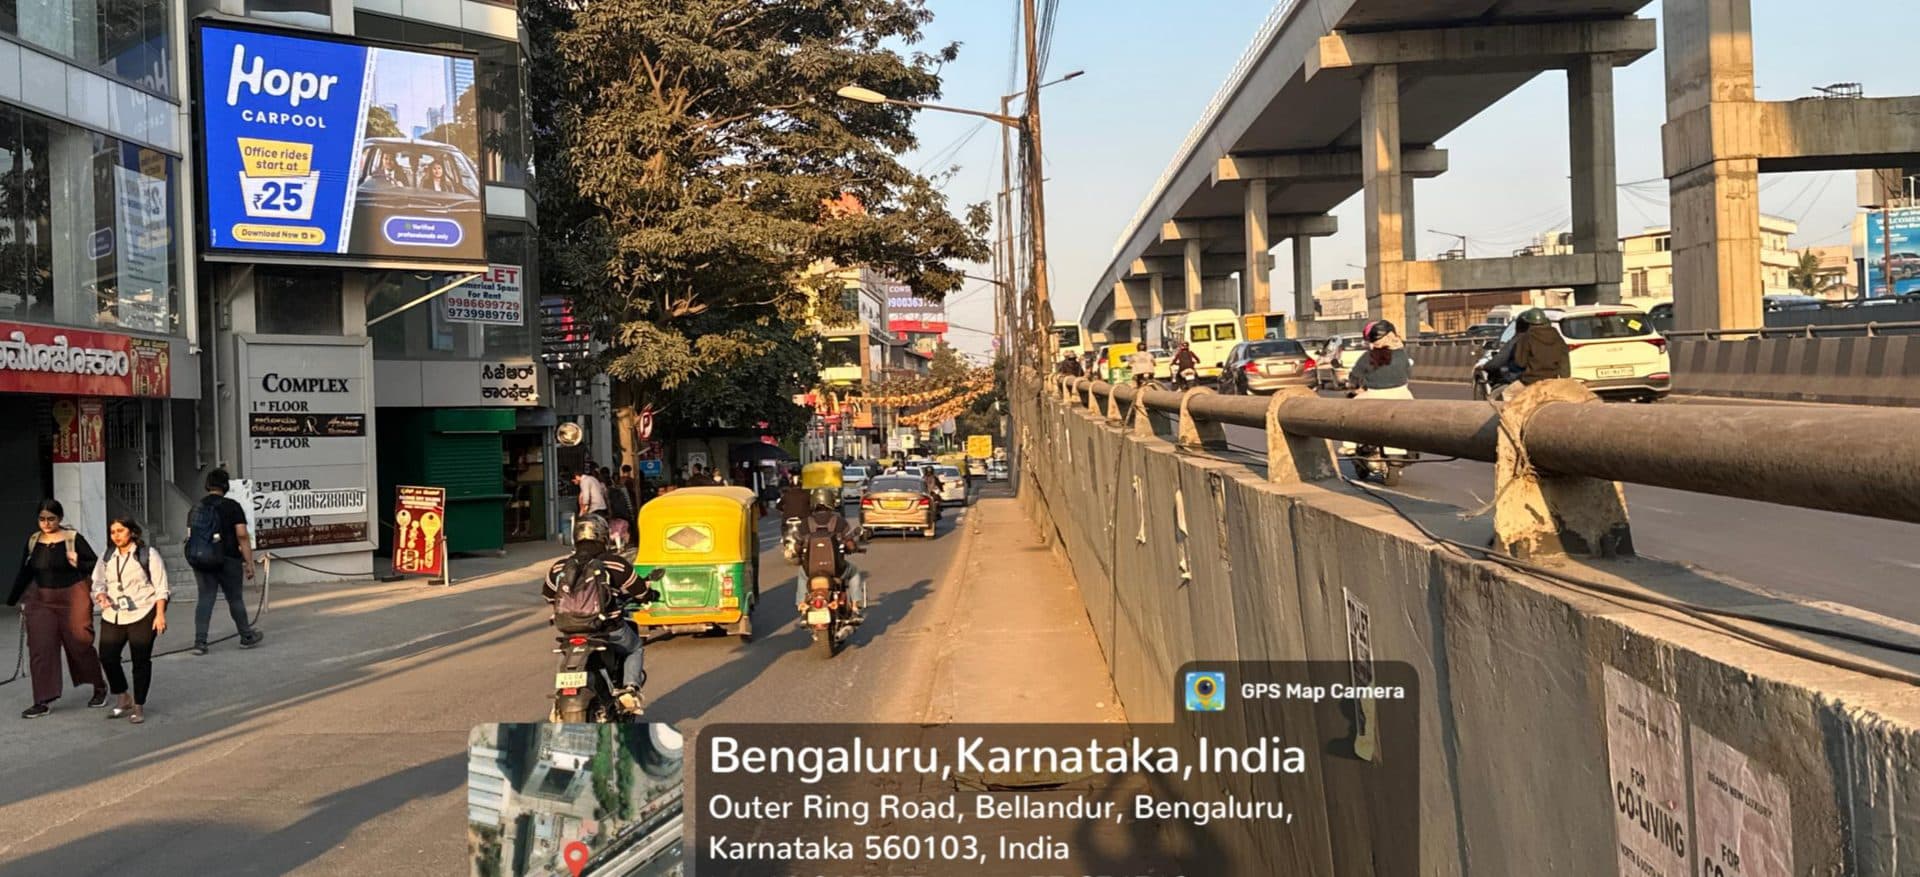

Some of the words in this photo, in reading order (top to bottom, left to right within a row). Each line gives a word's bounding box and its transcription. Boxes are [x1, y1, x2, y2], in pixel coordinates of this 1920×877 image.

[227, 43, 338, 107] Hopr
[242, 109, 327, 129] CARPOOL
[244, 146, 278, 159] Office
[280, 149, 308, 160] rides
[256, 160, 284, 170] start
[286, 162, 298, 171] at
[242, 229, 280, 238] Download
[282, 230, 299, 238] Now
[468, 290, 481, 298] For
[483, 291, 502, 300] Rent
[448, 298, 520, 311] 9986699729
[448, 308, 520, 321] 9739989769
[268, 400, 309, 412] FLOOR
[270, 438, 310, 449] FLOOR
[271, 479, 311, 492] FLOOR
[253, 494, 282, 513] Spa
[289, 491, 364, 510] 9986288099
[272, 515, 312, 528] FLOOR
[1630, 767, 1646, 792] FOR
[1617, 780, 1685, 858] CO-LIVING
[1721, 843, 1740, 873] FOR
